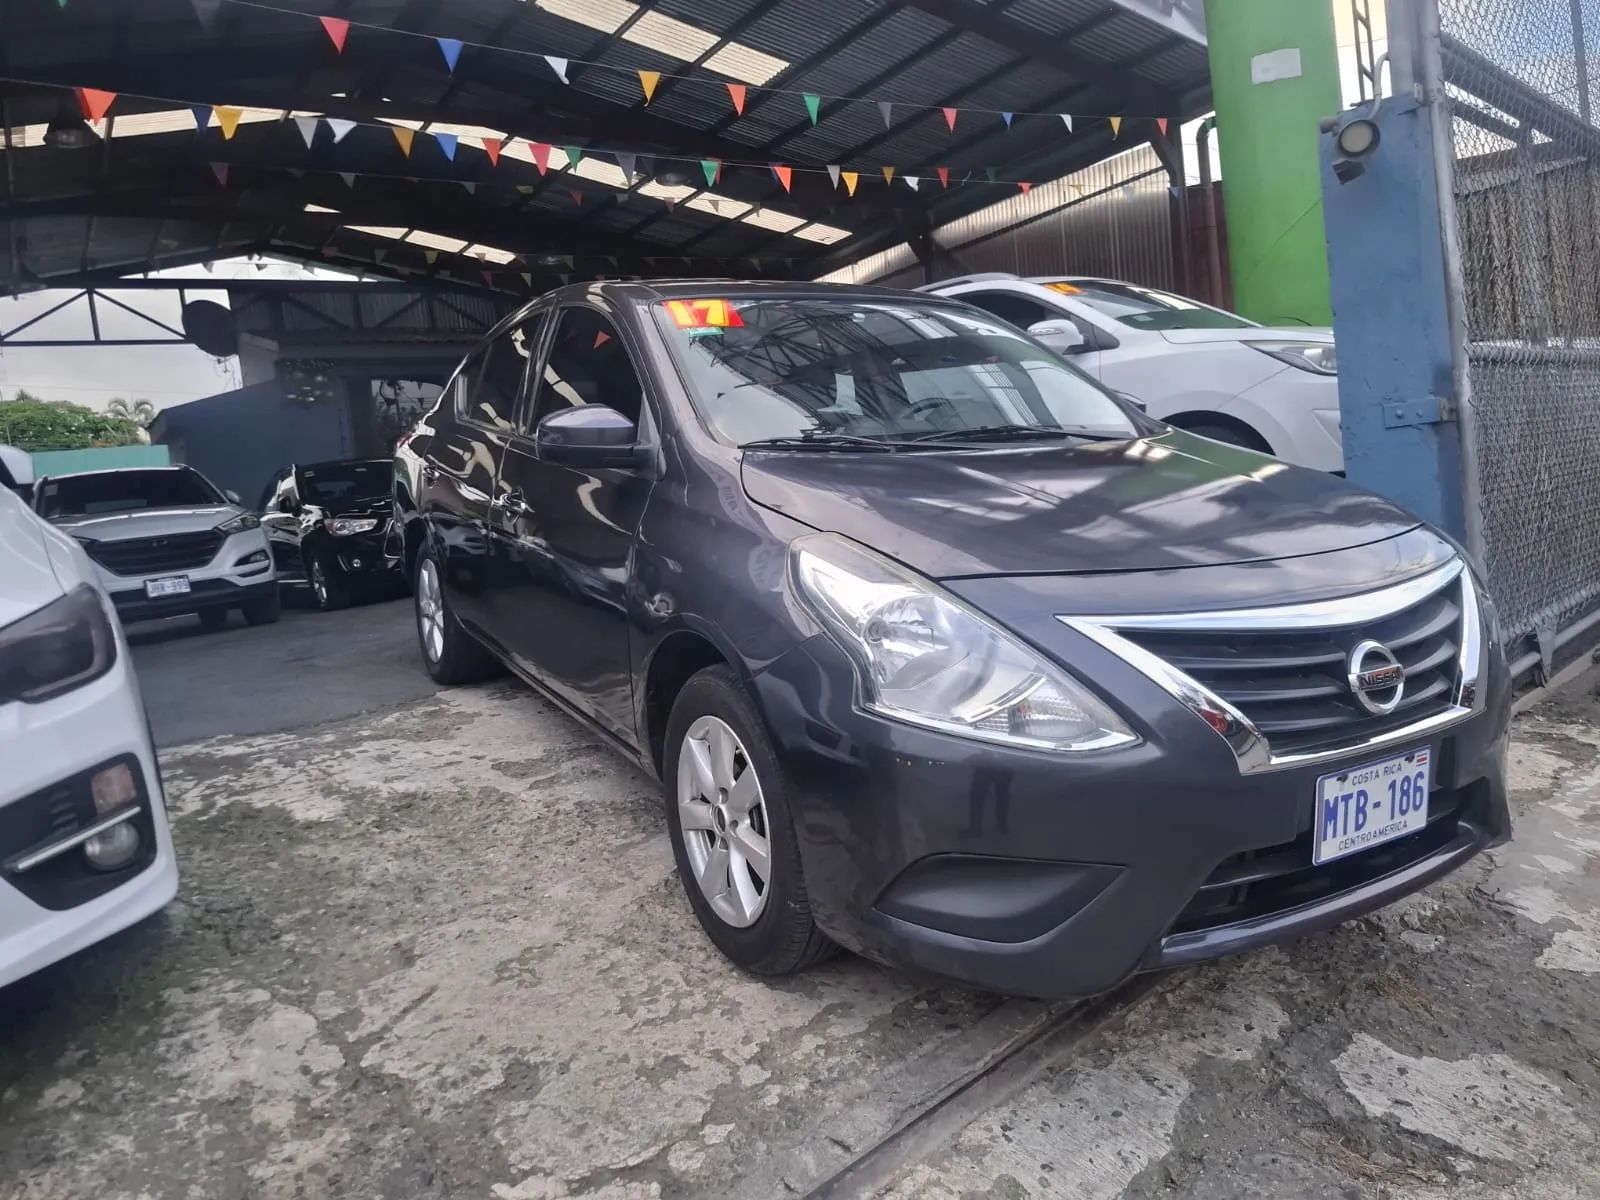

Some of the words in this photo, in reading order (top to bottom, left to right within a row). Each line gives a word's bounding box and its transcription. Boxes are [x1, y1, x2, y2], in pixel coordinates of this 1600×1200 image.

[667, 299, 728, 326] 17
[1352, 771, 1380, 786] COSTA
[1383, 762, 1402, 776] RICA
[1322, 771, 1425, 842] MTB-186
[1338, 820, 1408, 851] CENTROAMERICA
